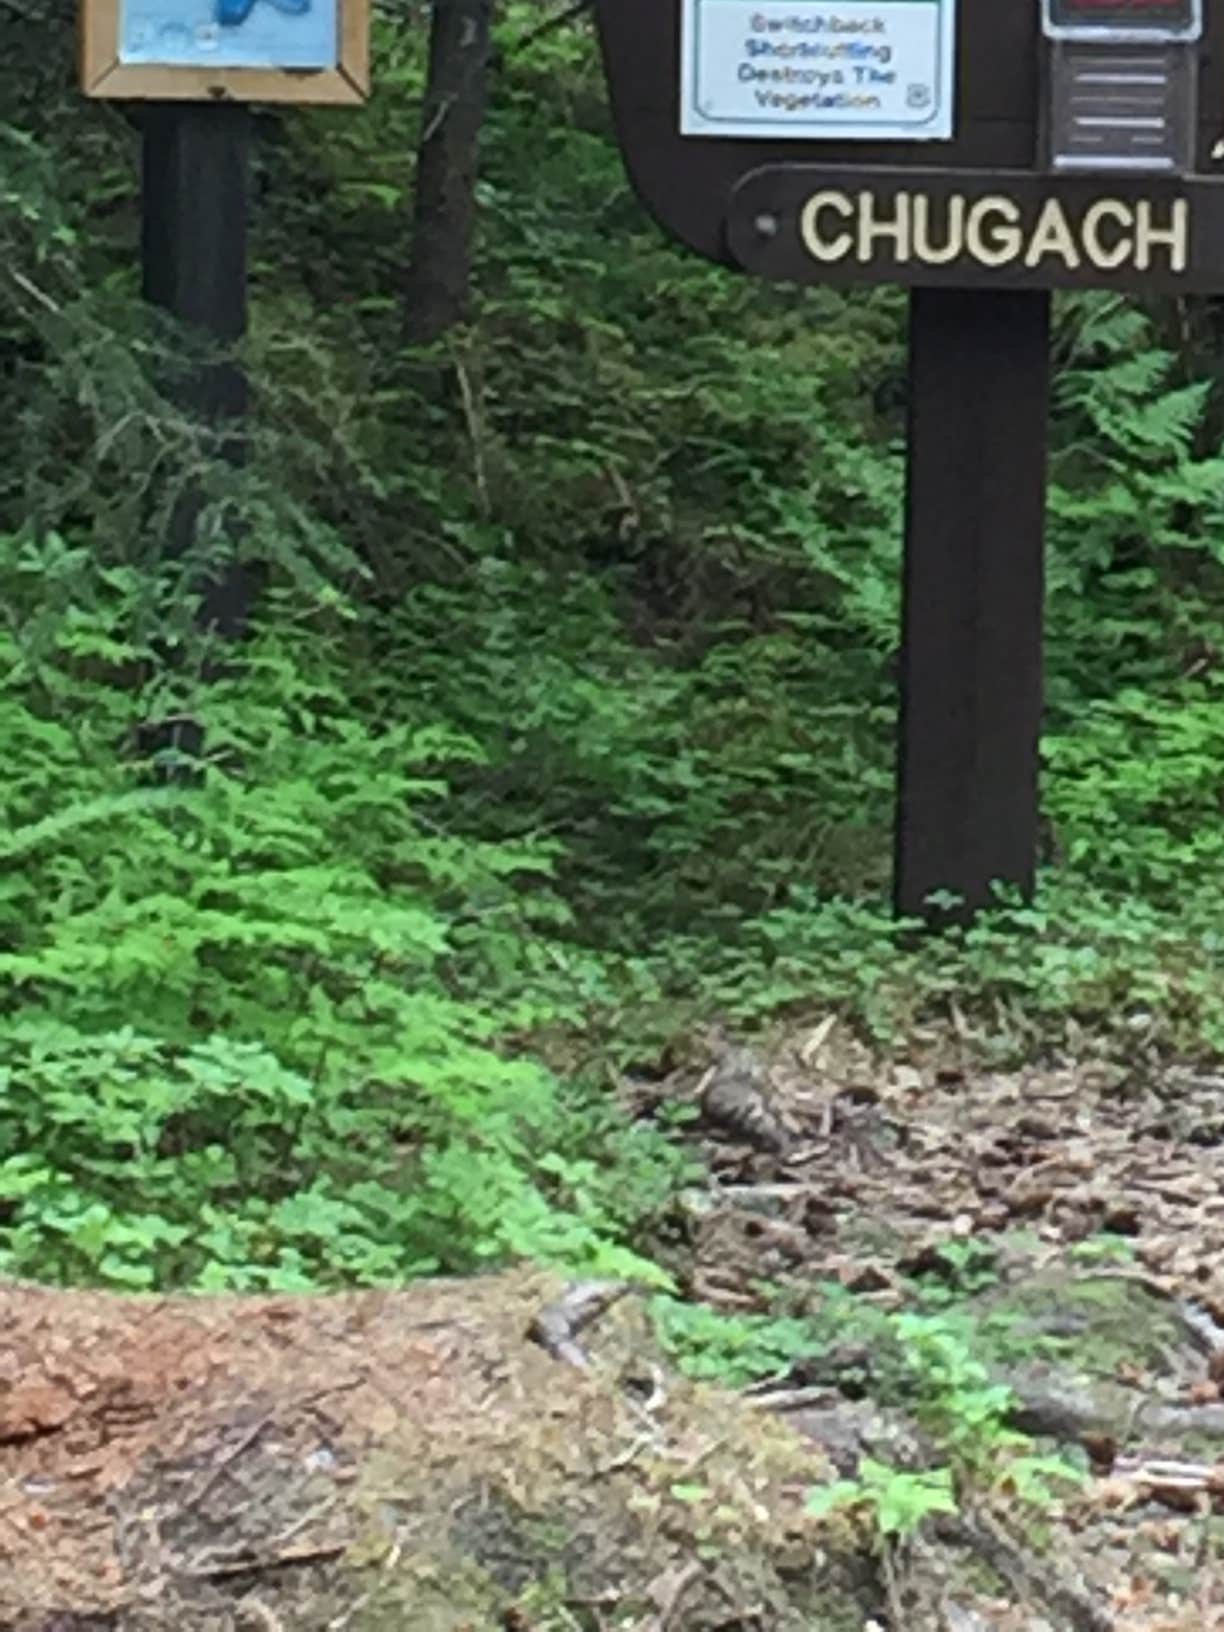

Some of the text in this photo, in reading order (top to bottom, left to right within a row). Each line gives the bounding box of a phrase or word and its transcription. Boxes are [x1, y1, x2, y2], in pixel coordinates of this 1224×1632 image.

[750, 14, 885, 34] Switchback
[744, 38, 892, 64] Shortcutting
[737, 63, 896, 87] Destroys The
[754, 90, 881, 111] Vegetation
[800, 190, 1188, 272] CHUGACH
